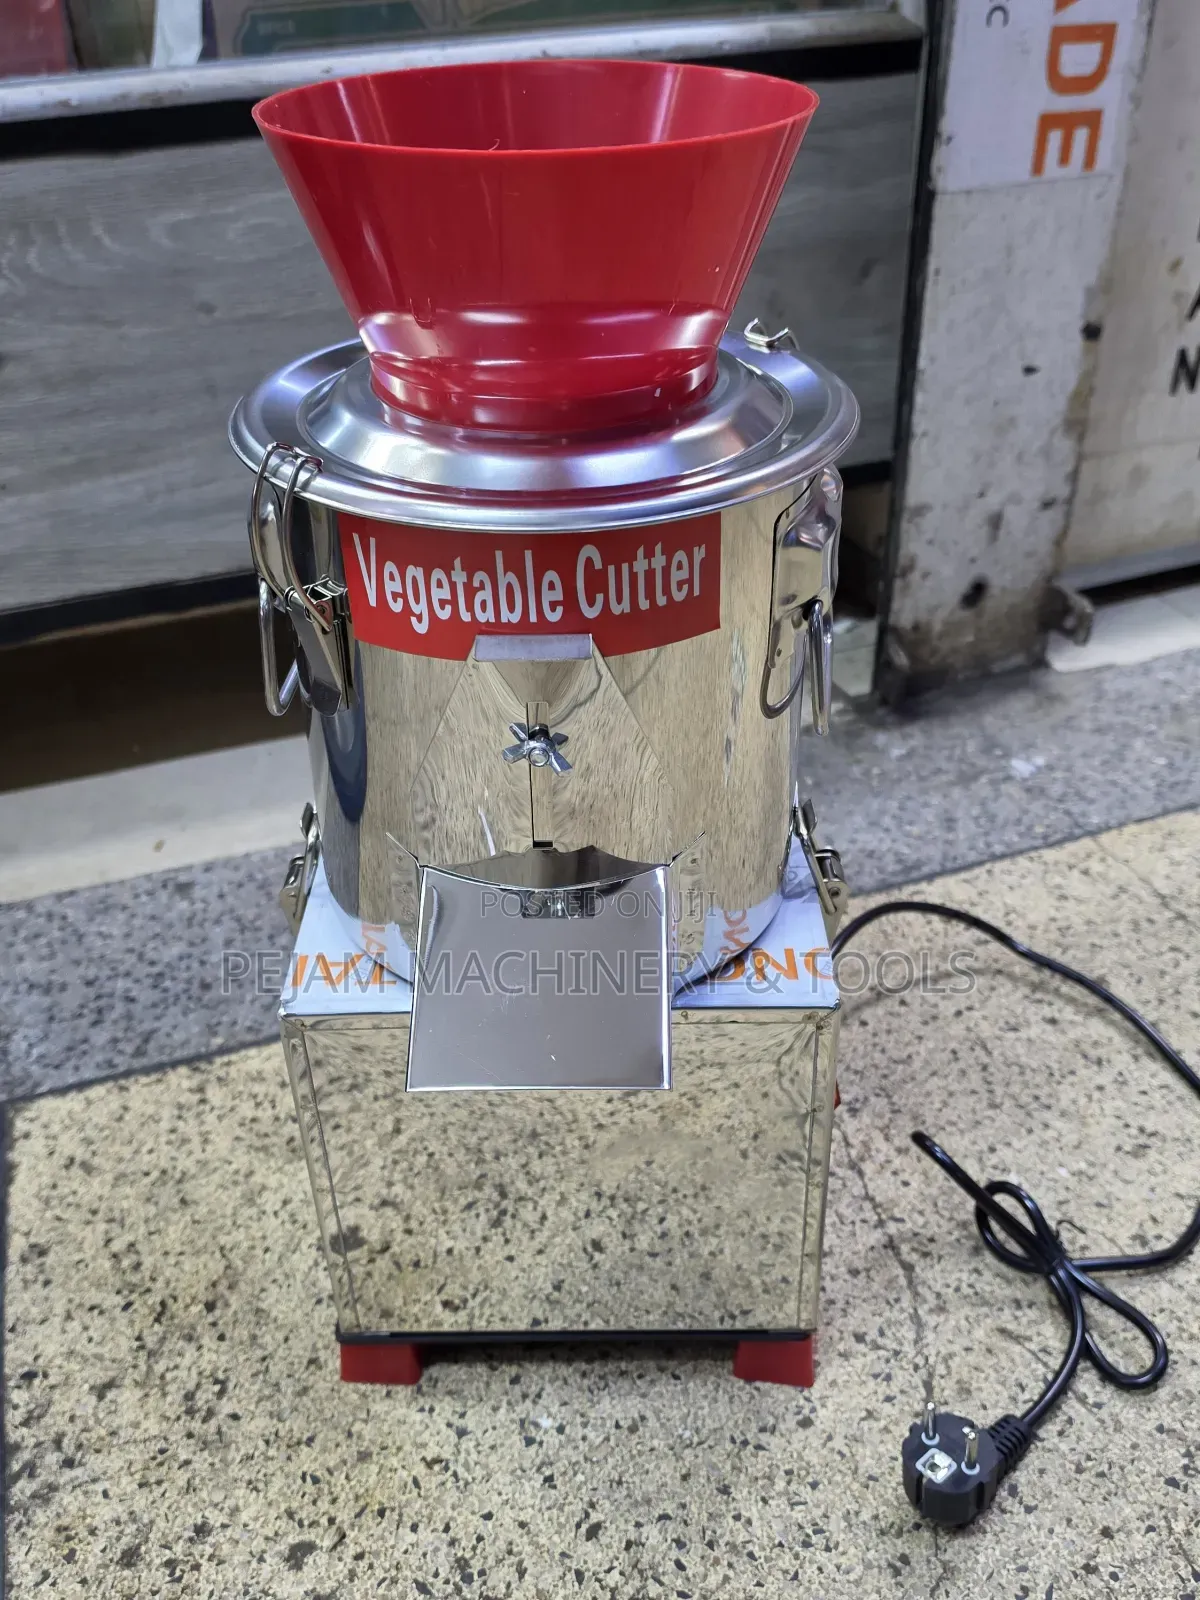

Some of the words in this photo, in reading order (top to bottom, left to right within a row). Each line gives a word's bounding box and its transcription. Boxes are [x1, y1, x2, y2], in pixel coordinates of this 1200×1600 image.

[1031, 0, 1118, 178] DE
[352, 532, 563, 635] Vegetable
[576, 541, 706, 619] Cutter
